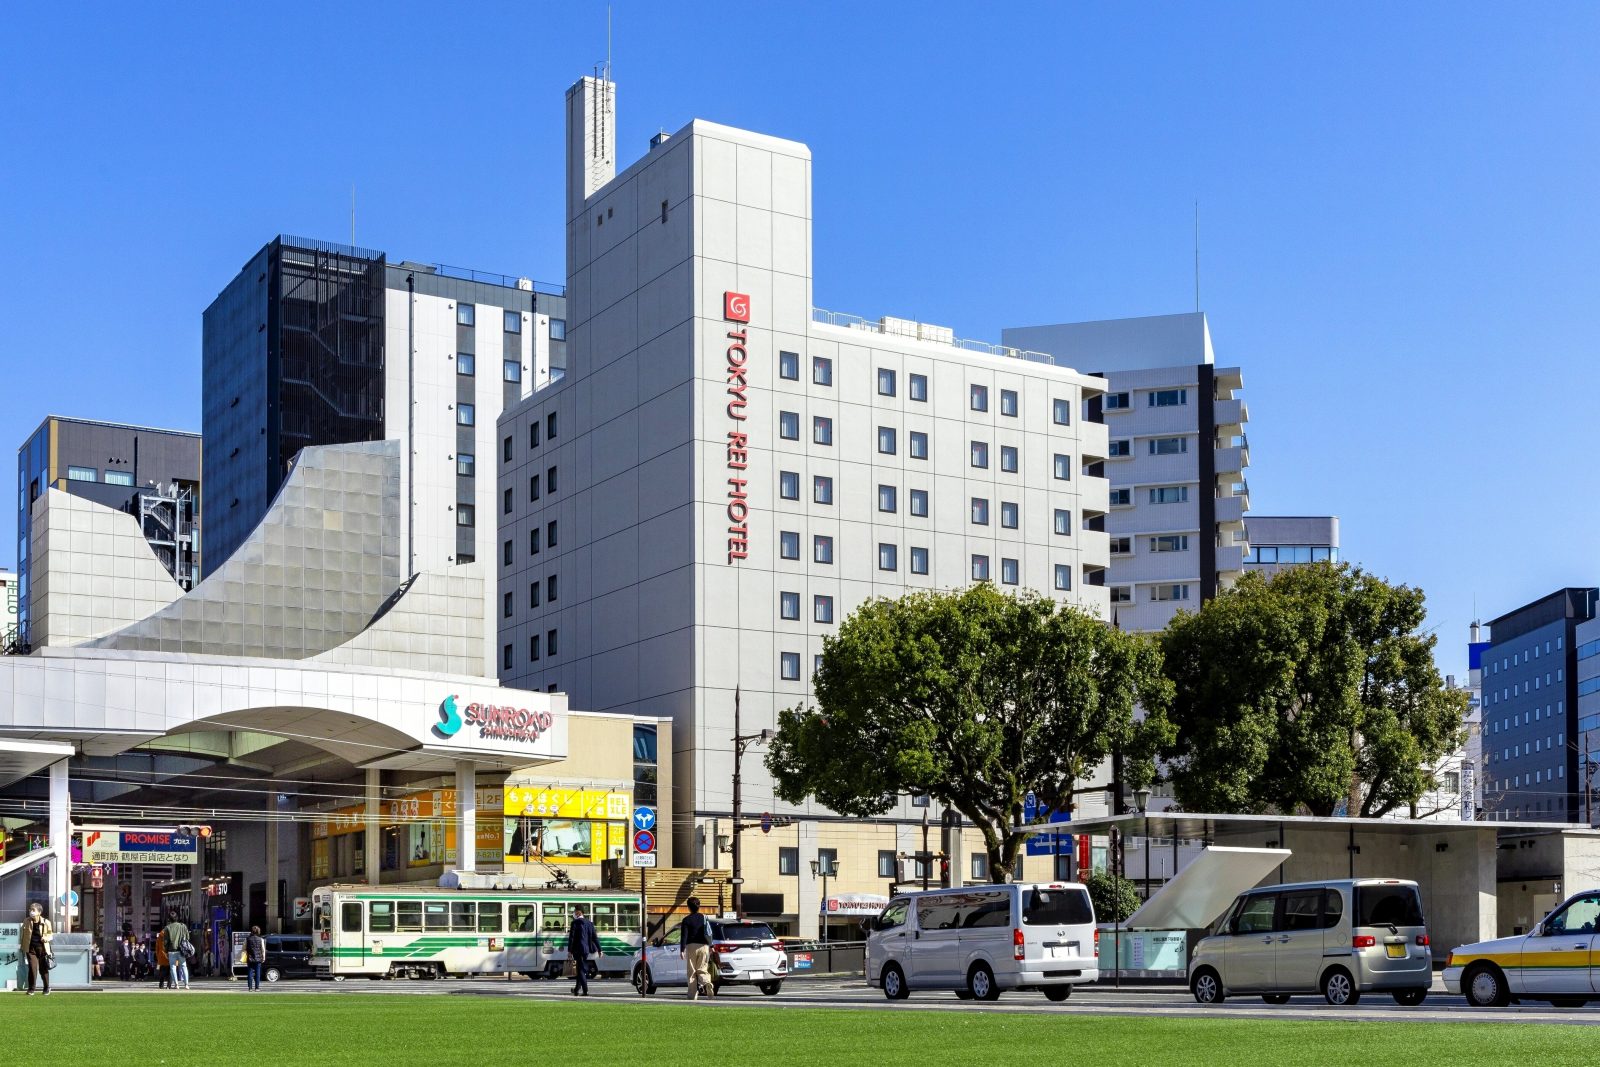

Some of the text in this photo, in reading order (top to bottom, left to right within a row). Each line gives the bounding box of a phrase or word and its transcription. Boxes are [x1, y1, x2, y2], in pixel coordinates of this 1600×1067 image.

[727, 329, 749, 565] TOKYU REI HOTEL
[464, 702, 553, 733] SUNROAD
[125, 834, 170, 844] PROMISE
[92, 851, 119, 861] 通町筋
